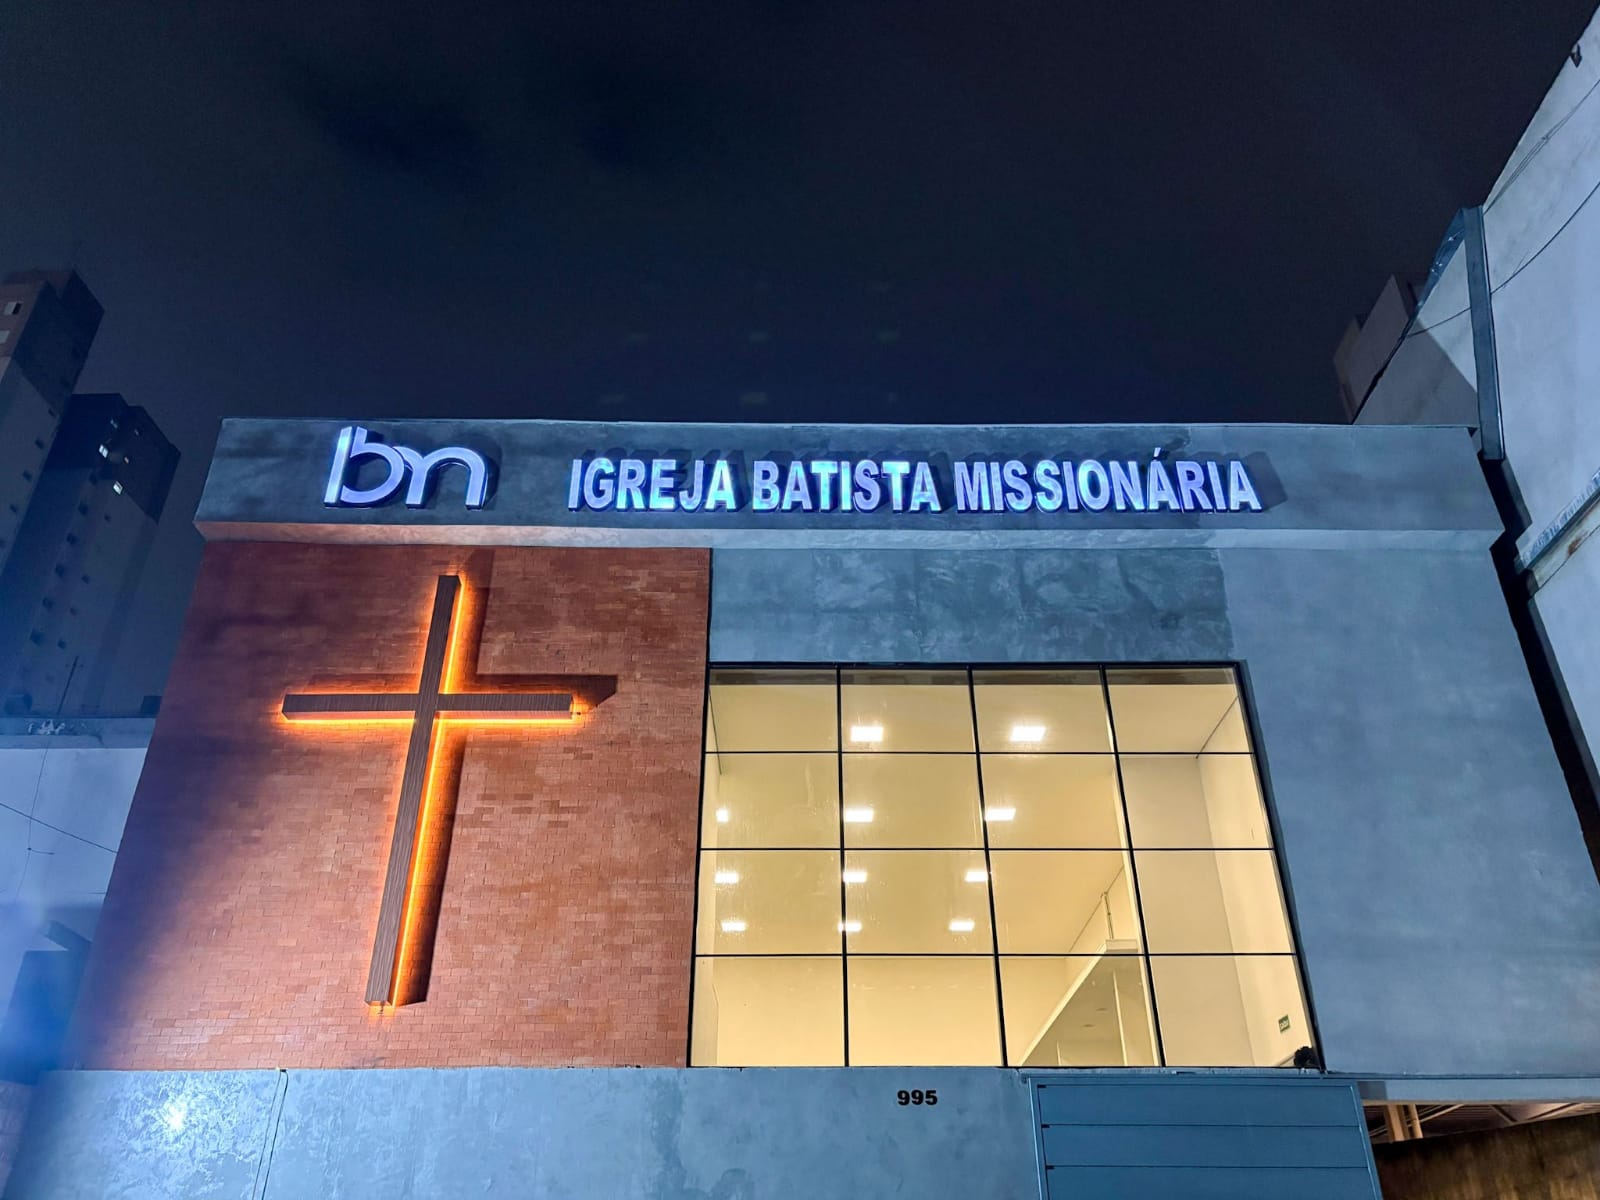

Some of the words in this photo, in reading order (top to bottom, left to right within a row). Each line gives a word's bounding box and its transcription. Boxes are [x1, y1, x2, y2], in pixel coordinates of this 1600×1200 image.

[568, 458, 737, 512] IGREJA
[752, 459, 942, 512] BATISTA
[954, 447, 1263, 513] MISSIONÁRIA
[897, 1089, 938, 1106] 995
